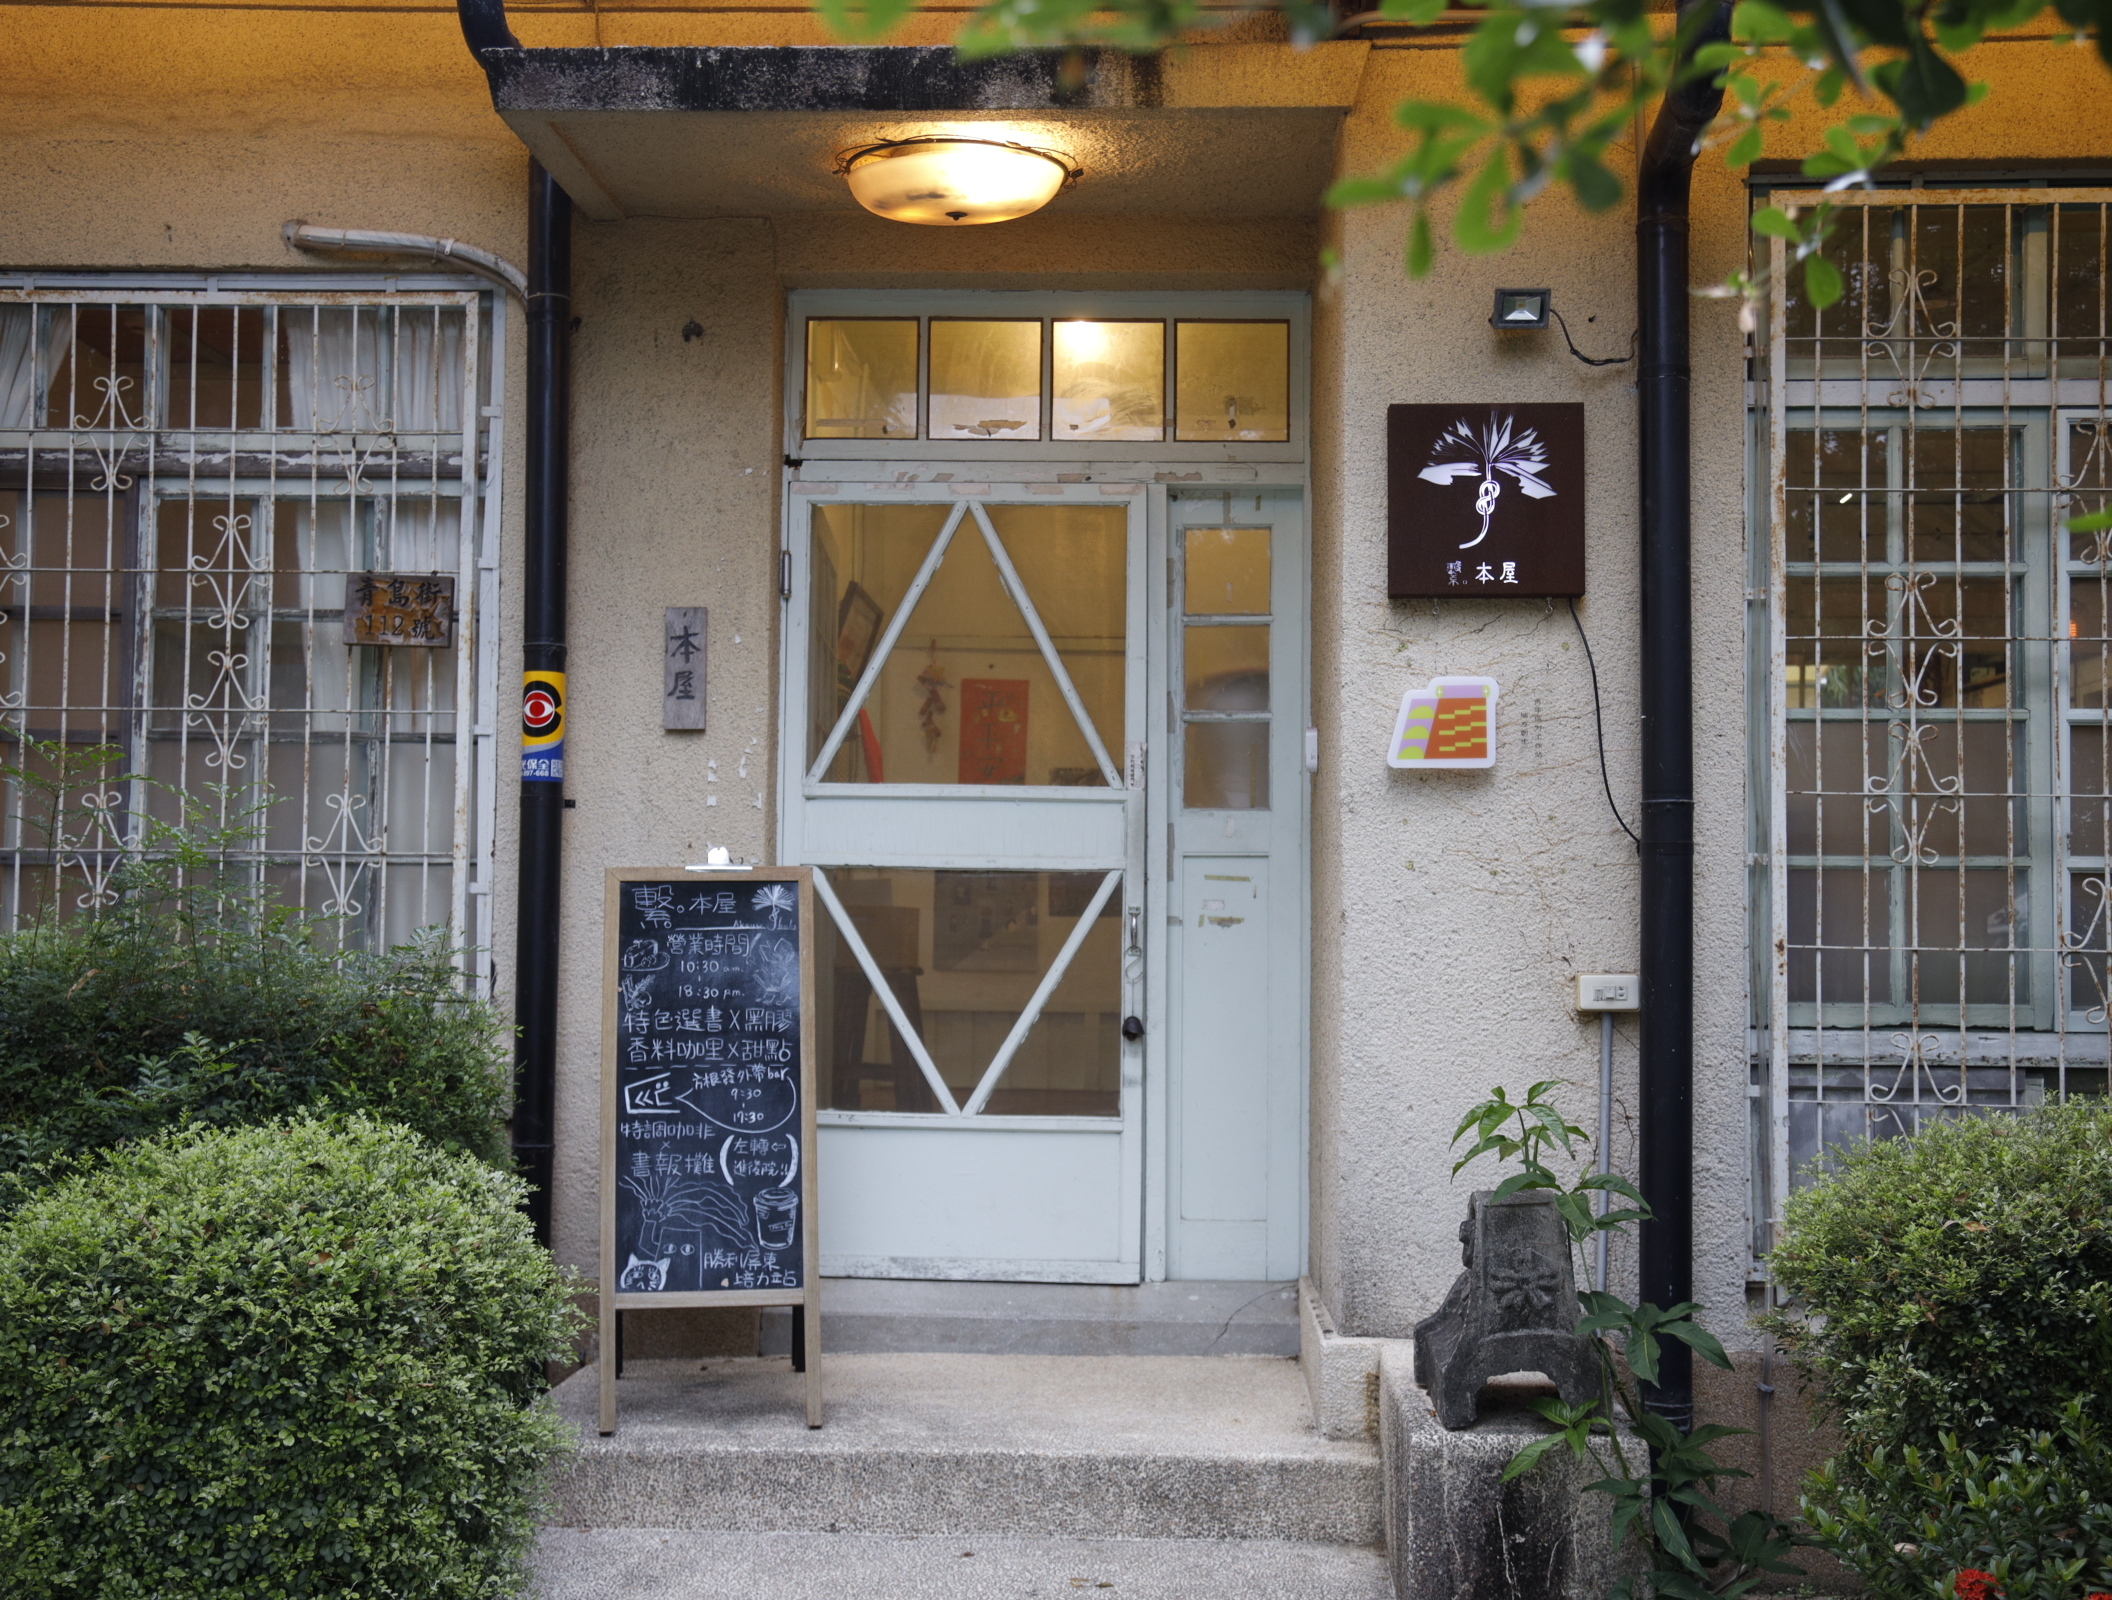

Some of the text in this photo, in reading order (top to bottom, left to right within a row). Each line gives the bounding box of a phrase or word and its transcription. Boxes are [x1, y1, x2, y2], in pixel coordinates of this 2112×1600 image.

[355, 577, 443, 607] 青島街
[365, 615, 435, 640] 112號
[667, 625, 701, 700] 本屋
[666, 933, 750, 957] 營業時間
[680, 960, 719, 973] 10:30
[678, 984, 719, 999] 18:30
[730, 1087, 762, 1101] 9:30
[733, 1110, 765, 1124] 17:30
[630, 1149, 715, 1177] 書報攤
[733, 1269, 797, 1288] 培力站
